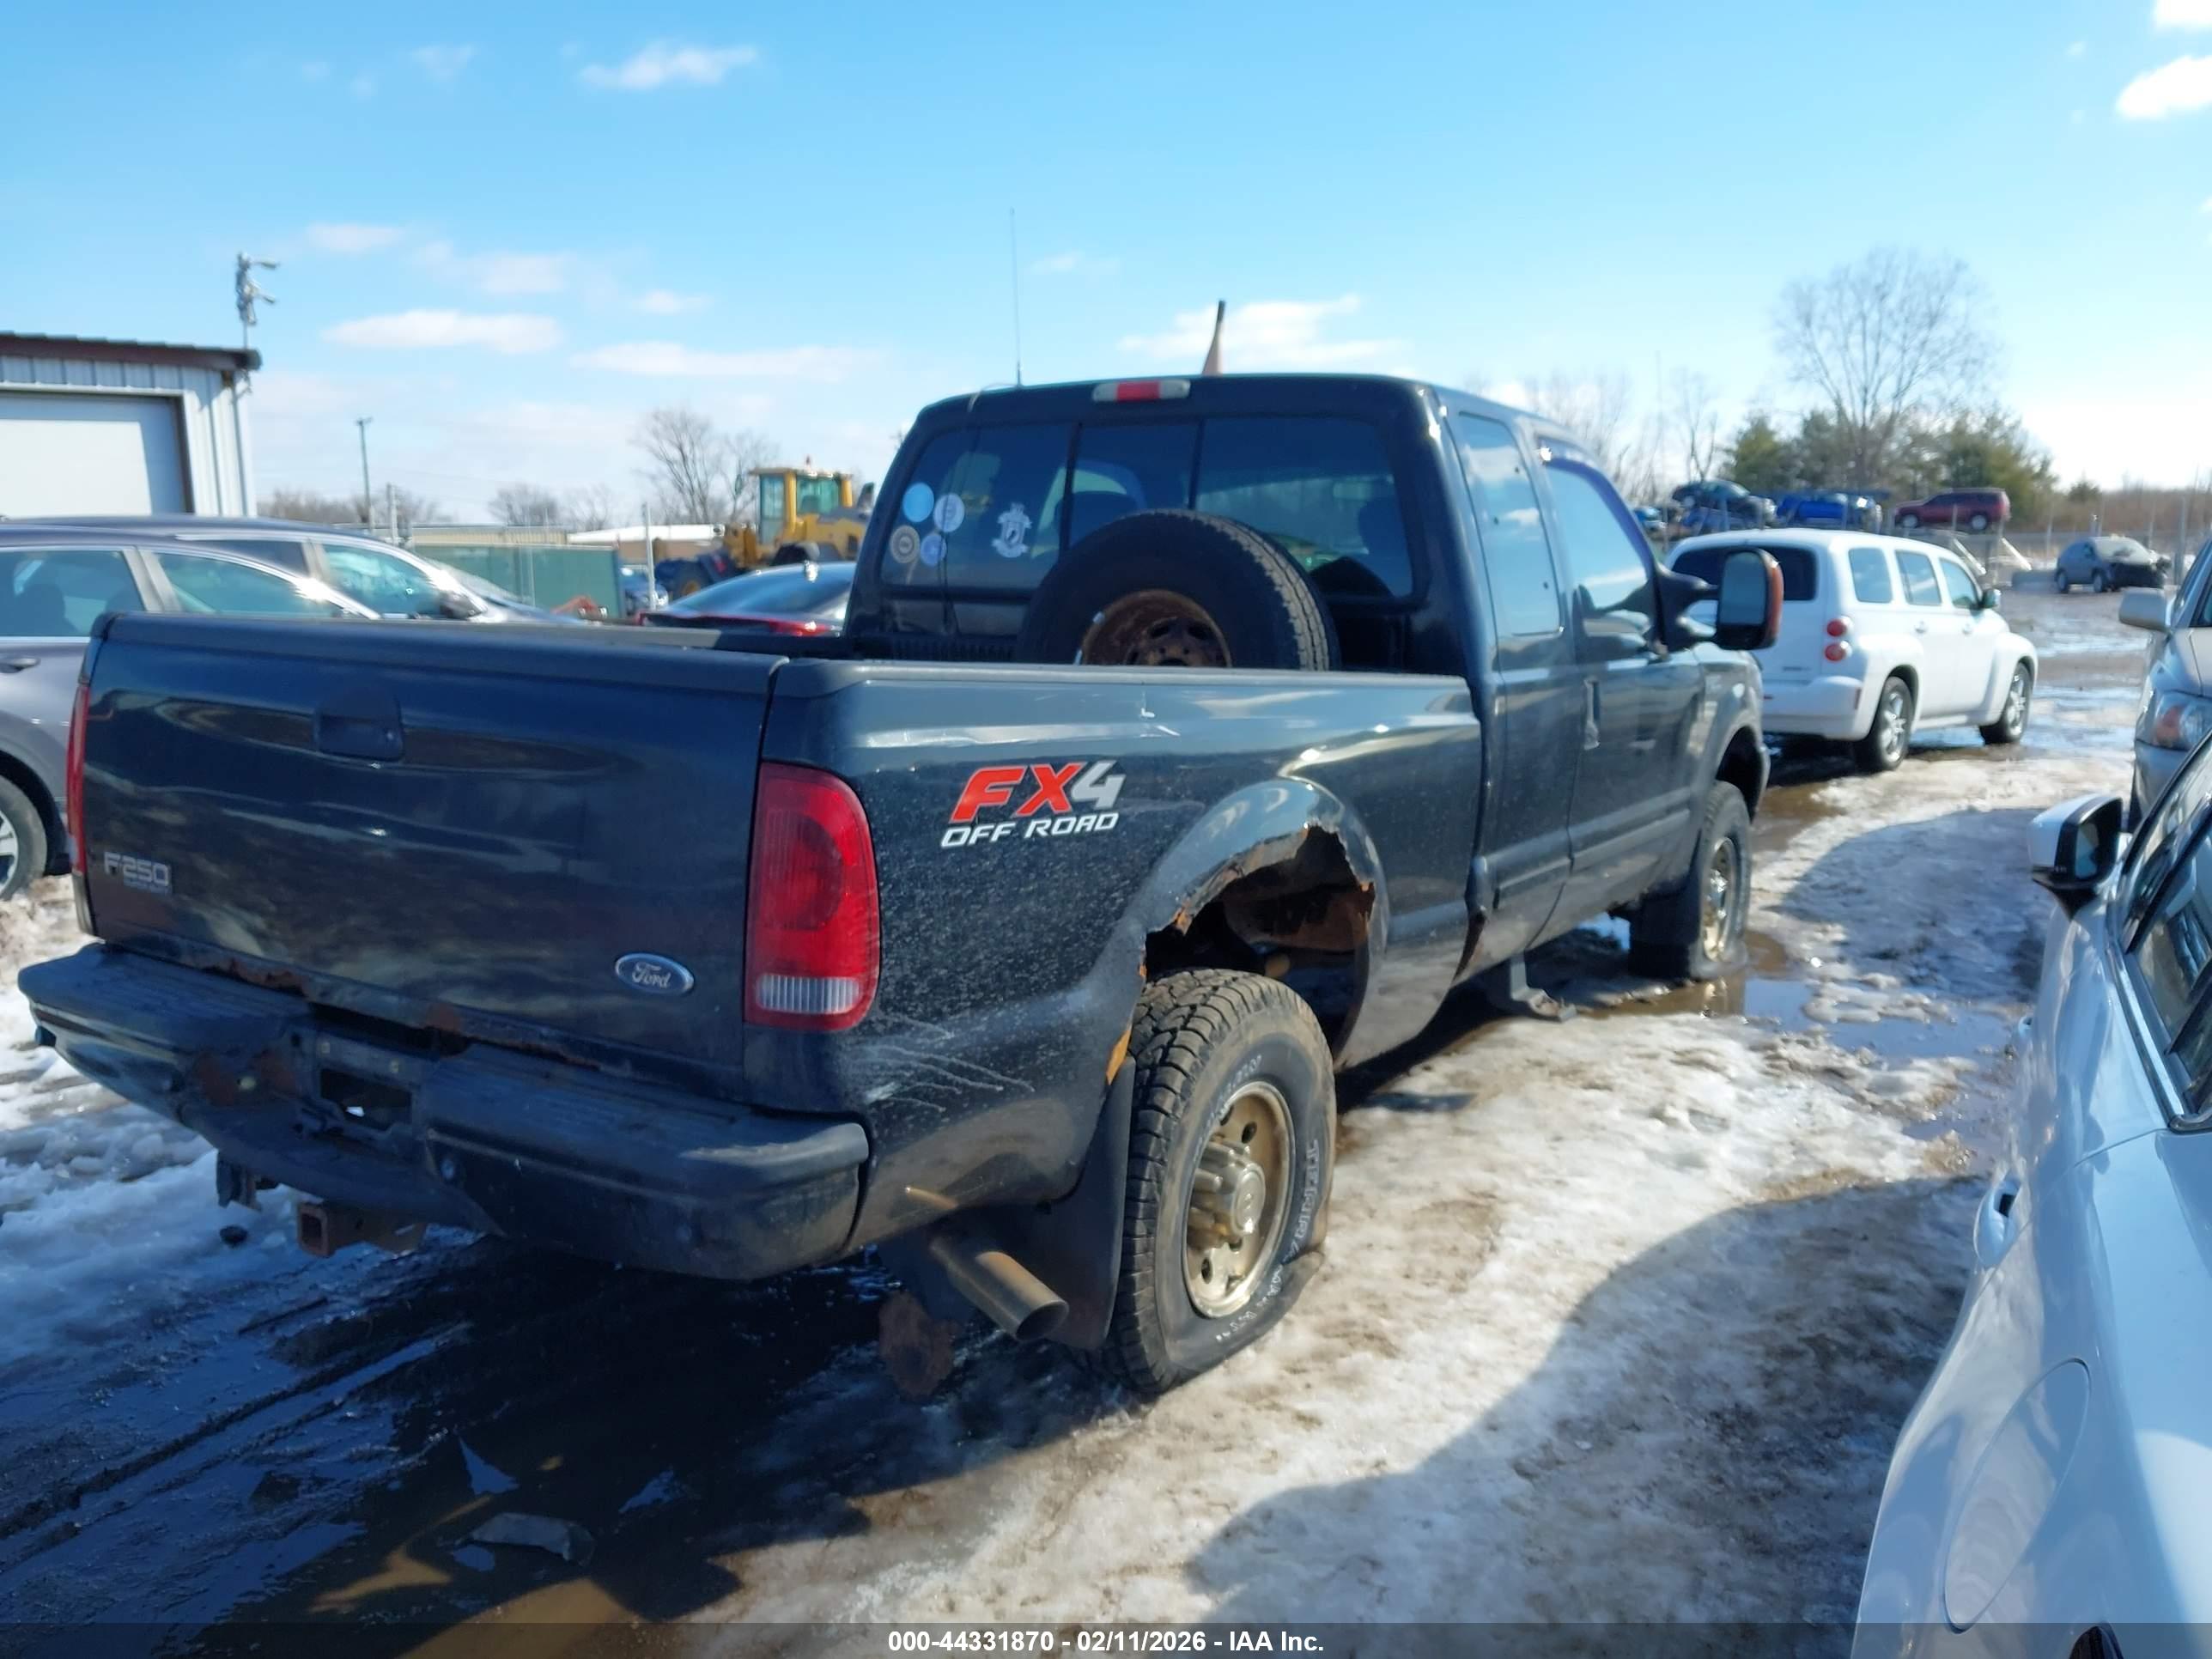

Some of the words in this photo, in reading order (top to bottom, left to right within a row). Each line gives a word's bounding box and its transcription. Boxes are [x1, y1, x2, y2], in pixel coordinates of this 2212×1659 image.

[949, 760, 1126, 823] FX4
[941, 822, 1016, 848] OFF
[1024, 812, 1119, 839] ROAD
[632, 961, 672, 988] Ford
